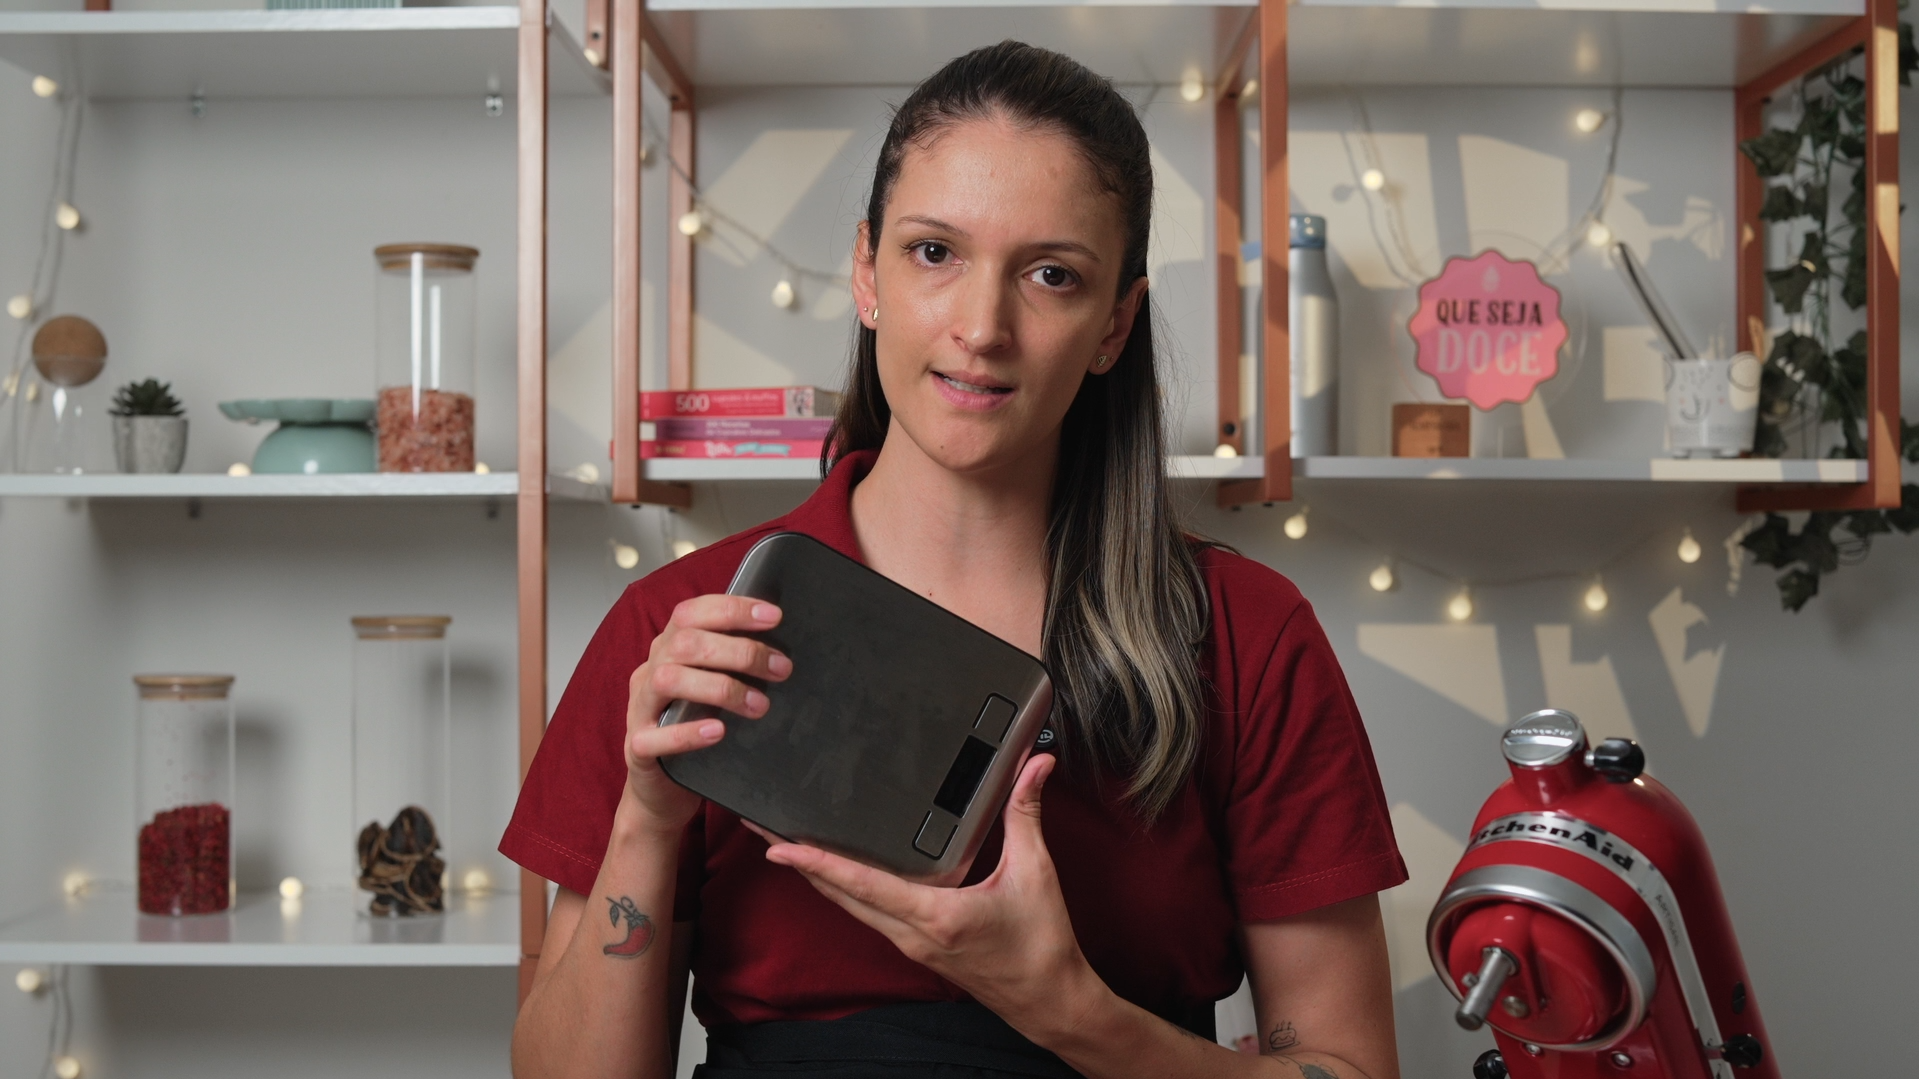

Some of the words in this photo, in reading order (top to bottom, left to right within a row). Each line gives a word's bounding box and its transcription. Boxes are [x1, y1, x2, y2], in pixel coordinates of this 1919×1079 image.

[1437, 299, 1480, 327] QUE
[1486, 301, 1543, 327] SEJA
[1437, 329, 1542, 376] DOCE
[675, 393, 710, 412] 500
